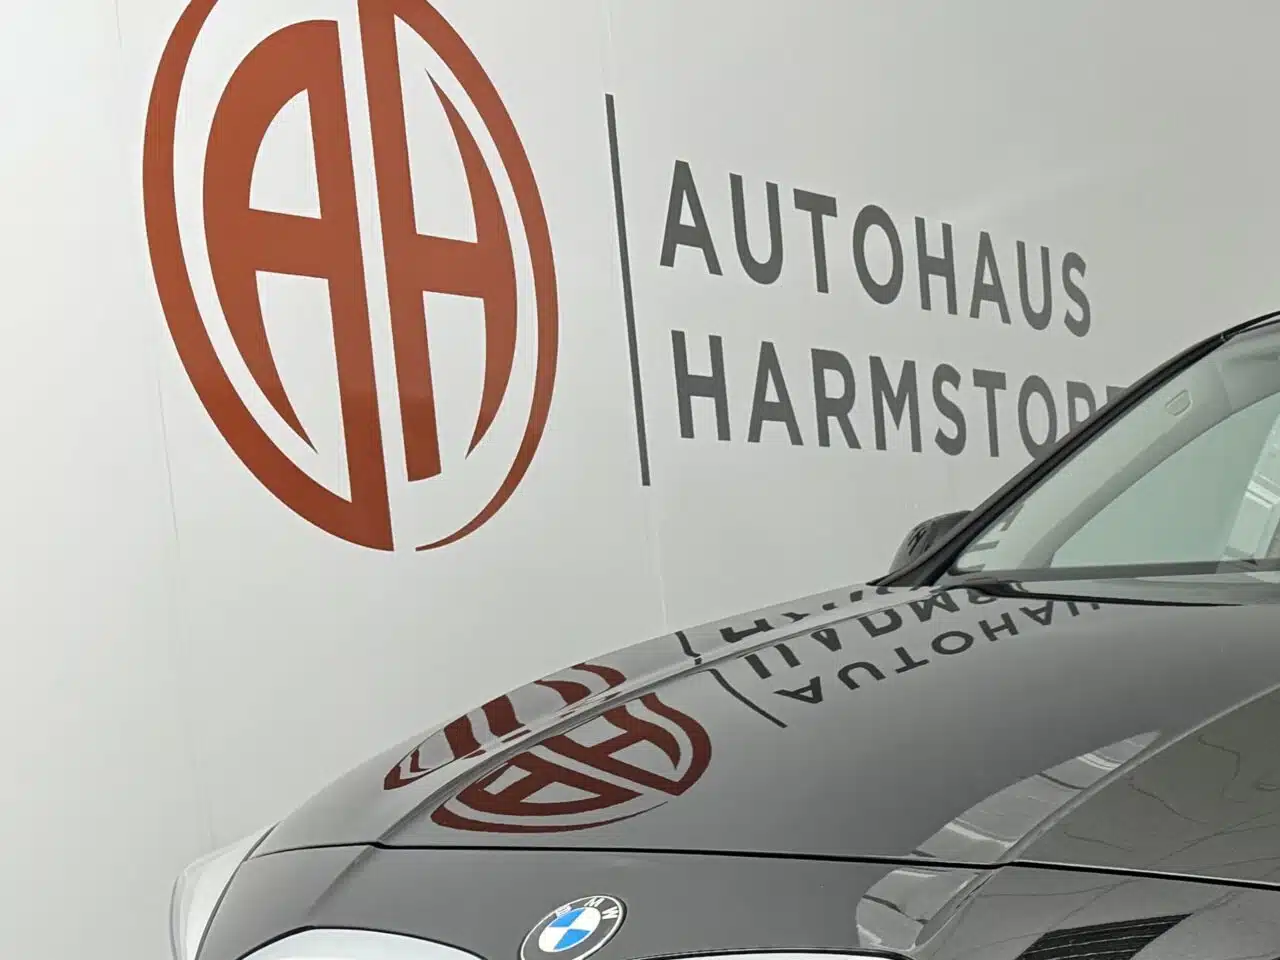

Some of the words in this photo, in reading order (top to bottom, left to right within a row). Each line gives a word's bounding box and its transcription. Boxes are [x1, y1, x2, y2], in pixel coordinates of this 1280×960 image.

[659, 159, 1092, 337] AUTOHAUS
[670, 329, 1129, 460] HARMSTOR
[555, 897, 620, 920] BMW
